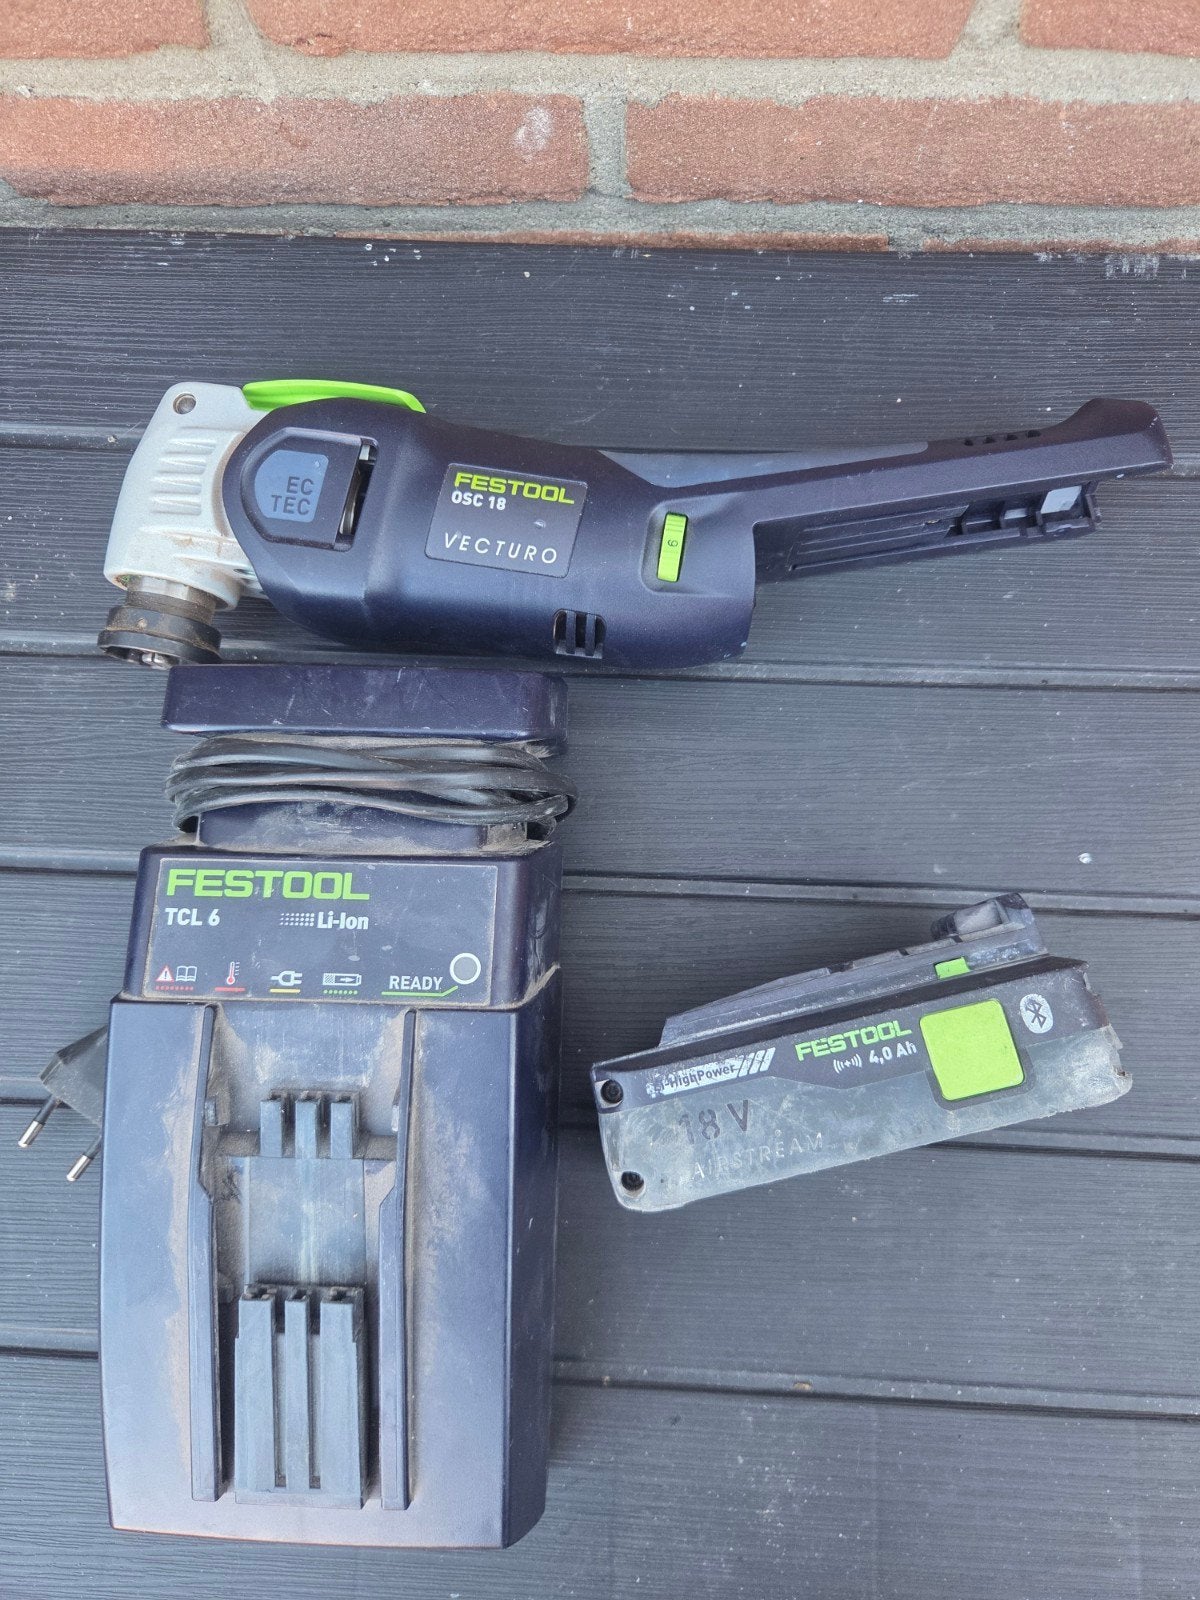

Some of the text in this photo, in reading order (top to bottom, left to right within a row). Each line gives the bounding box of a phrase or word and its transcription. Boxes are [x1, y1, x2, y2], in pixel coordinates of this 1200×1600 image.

[286, 476, 314, 495] EC
[453, 471, 575, 506] FESTOOL
[271, 494, 311, 515] TEC
[451, 490, 507, 511] OSC 18
[443, 532, 558, 565] VECTURO
[166, 868, 371, 900] FESTOOL
[164, 907, 221, 927] TCL 6
[316, 910, 370, 930] Li-Ion
[388, 975, 443, 991] READY
[795, 1020, 913, 1062] FESTOOL
[868, 1040, 918, 1066] 4,0 Ah
[678, 1099, 749, 1145] 18 V
[692, 1131, 824, 1181] AIRSTREAM
